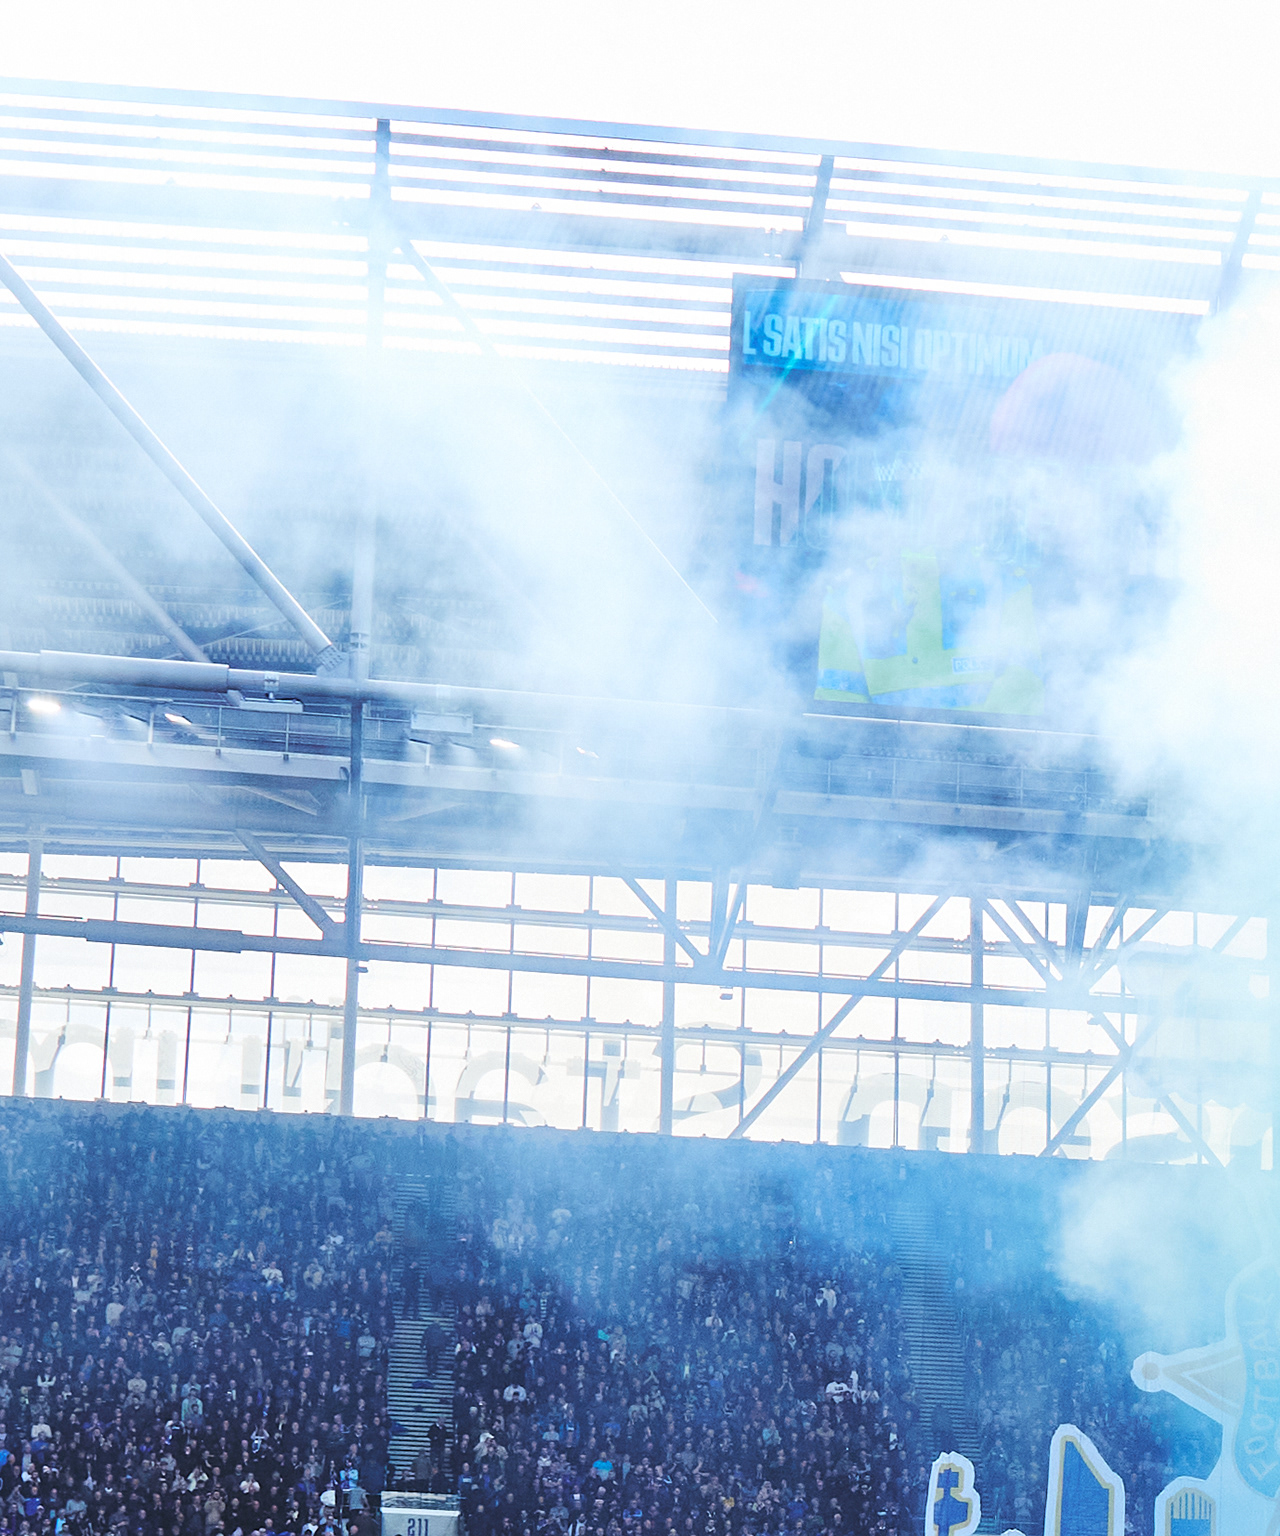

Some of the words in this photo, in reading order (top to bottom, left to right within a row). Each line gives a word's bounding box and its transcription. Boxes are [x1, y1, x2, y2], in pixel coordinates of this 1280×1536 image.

[762, 313, 847, 363] SATIS
[852, 321, 908, 368] NISI
[407, 1518, 429, 1536] 211
